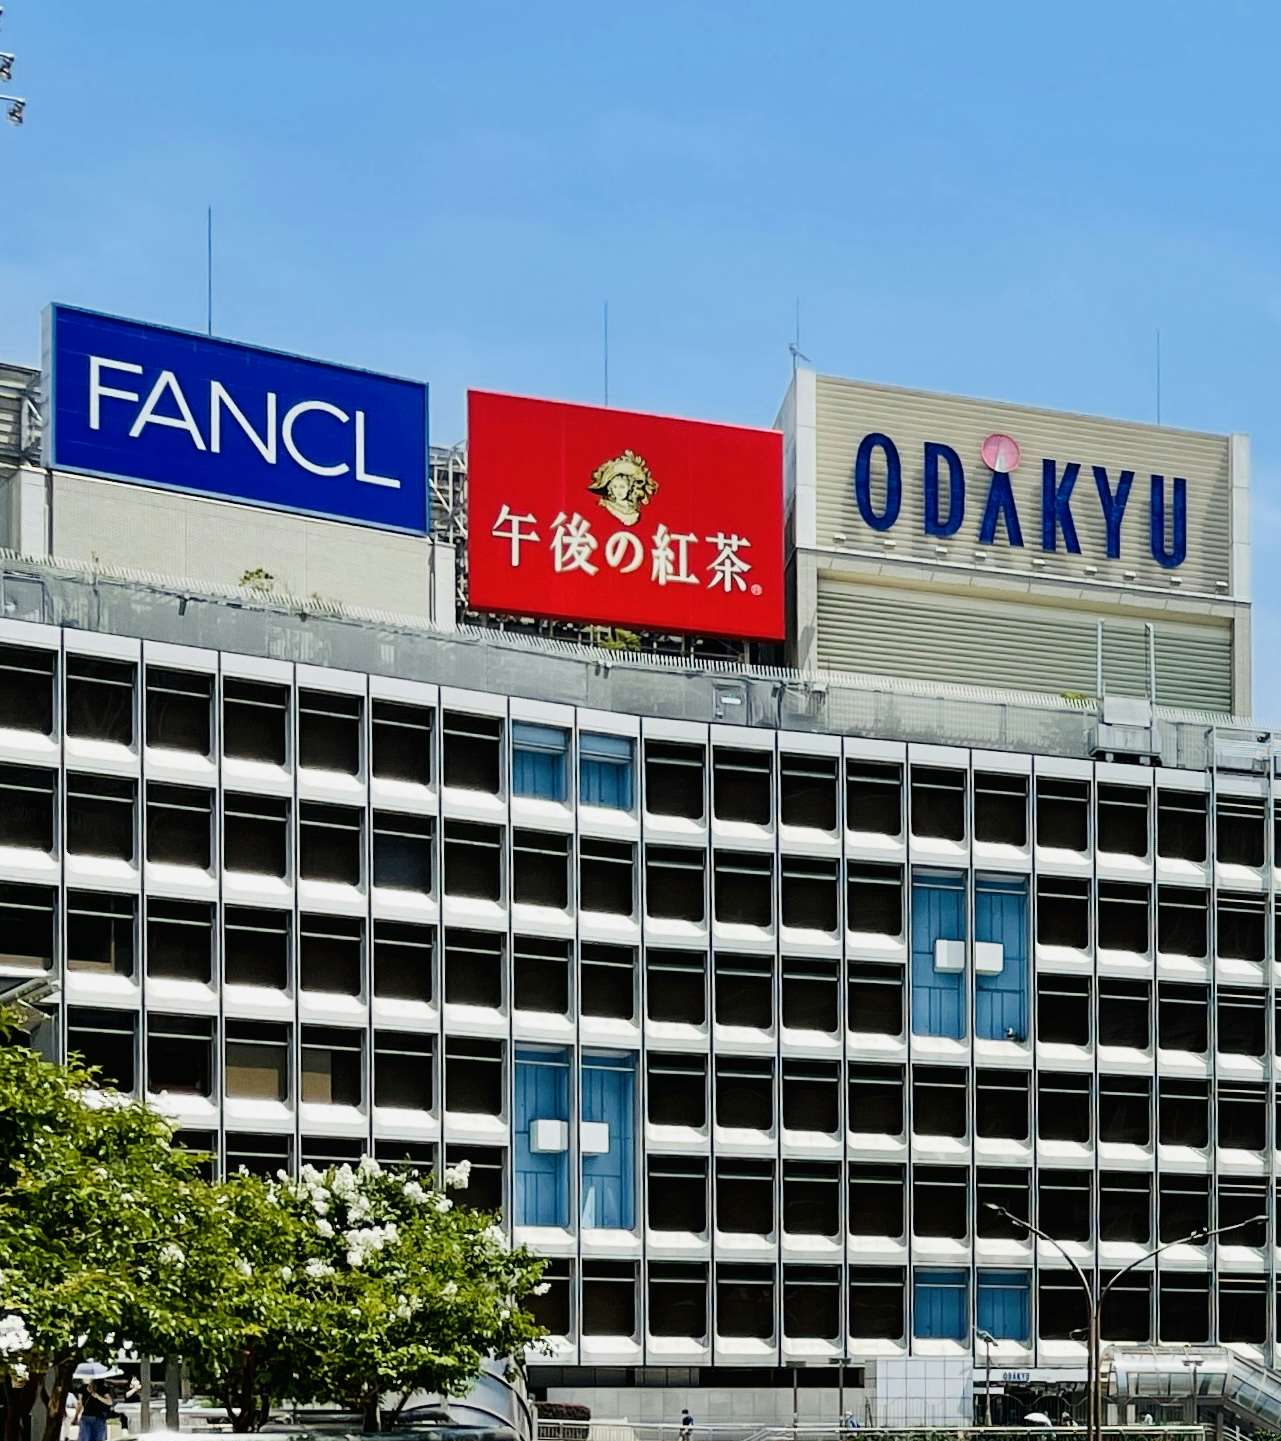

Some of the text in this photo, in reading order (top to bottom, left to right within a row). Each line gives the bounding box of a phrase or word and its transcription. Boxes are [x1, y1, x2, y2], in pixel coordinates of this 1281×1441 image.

[87, 355, 402, 490] FANCL
[491, 504, 752, 594] 午後の紅茶
[854, 432, 1188, 570] ODAKYU
